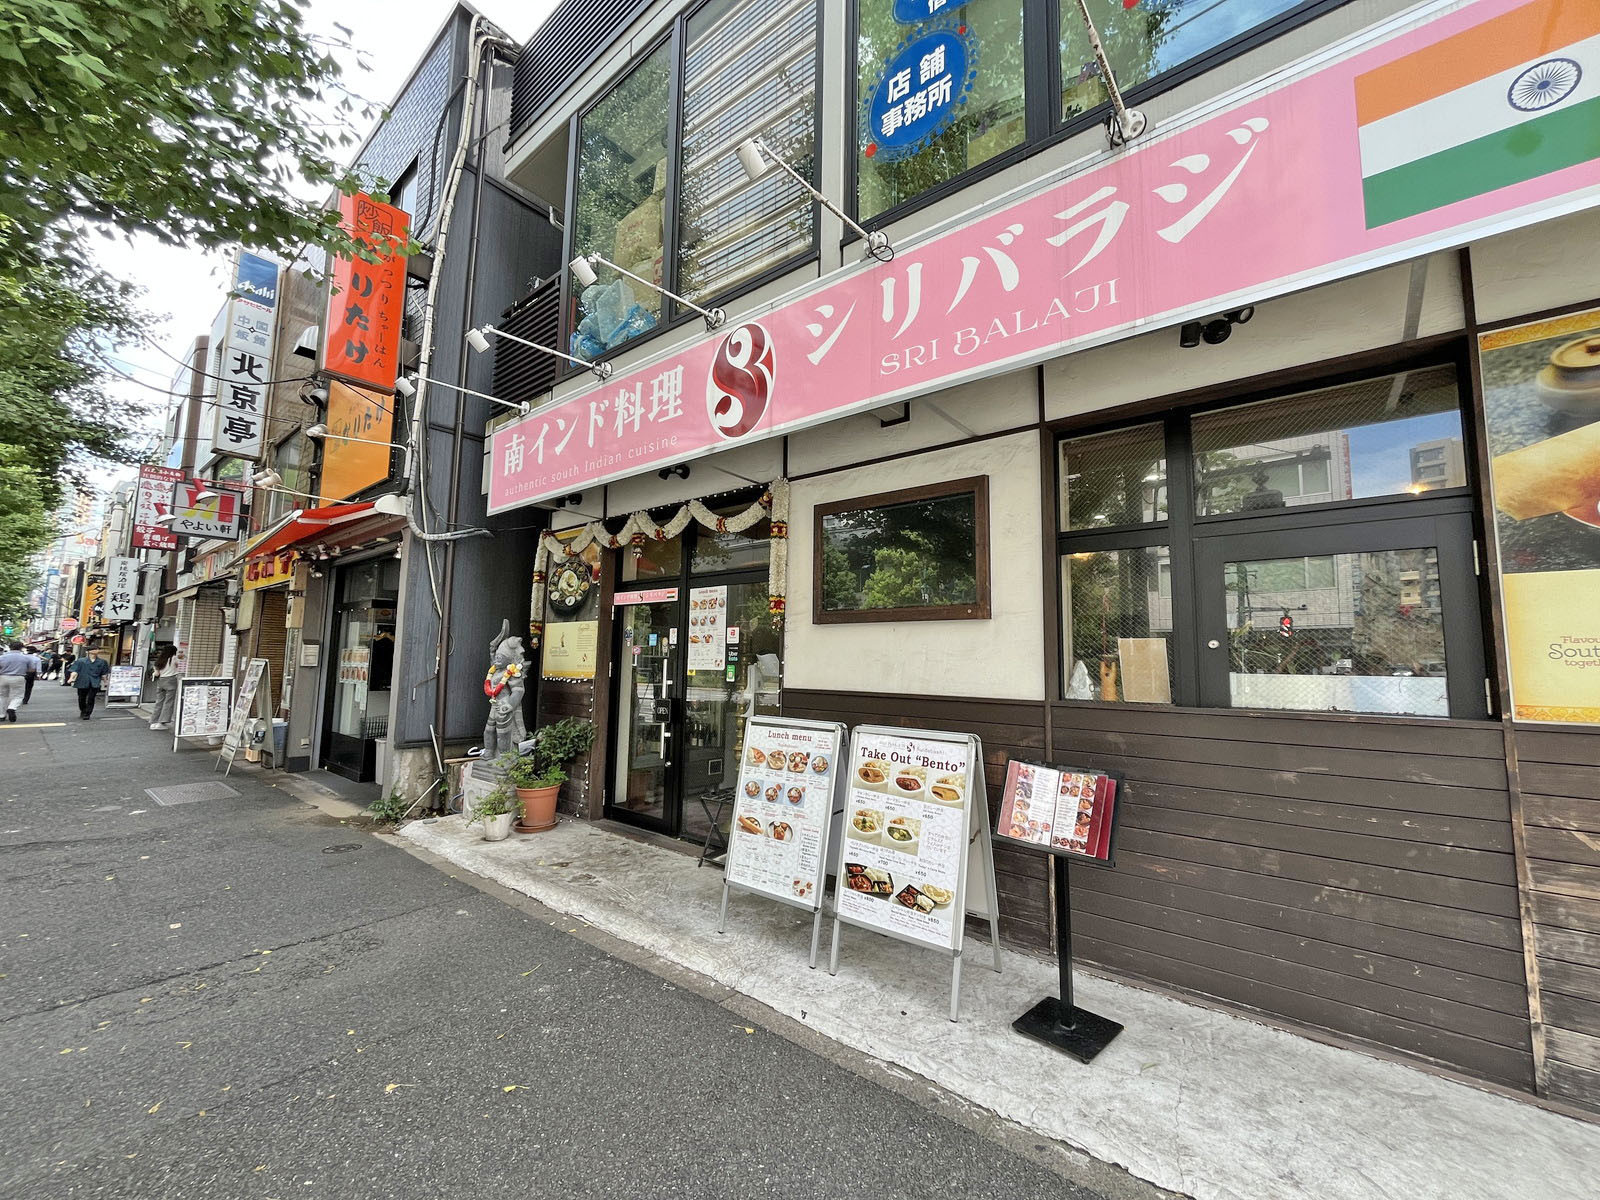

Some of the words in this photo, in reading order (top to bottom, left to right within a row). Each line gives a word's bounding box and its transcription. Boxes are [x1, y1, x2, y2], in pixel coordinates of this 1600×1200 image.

[881, 73, 952, 137] 事務所
[887, 44, 945, 104] 店舗
[805, 117, 1269, 366] シリバラジ
[237, 280, 275, 300] Asahi
[344, 236, 379, 364] りたけ
[879, 338, 938, 378] SRI
[953, 277, 1121, 358] BALAJI
[222, 352, 264, 444] 北京亭
[503, 364, 685, 477] 南インド料理
[504, 476, 547, 497] authentic
[551, 465, 580, 483] south
[628, 433, 678, 460] cuisine
[180, 519, 232, 534] やよい軒
[1564, 659, 1600, 669] toget
[656, 706, 669, 715] OPEN
[767, 730, 790, 740] Lunch
[791, 733, 812, 742] menu
[861, 746, 887, 760] Take
[890, 751, 912, 765] Out
[915, 755, 965, 772] “Bento”
